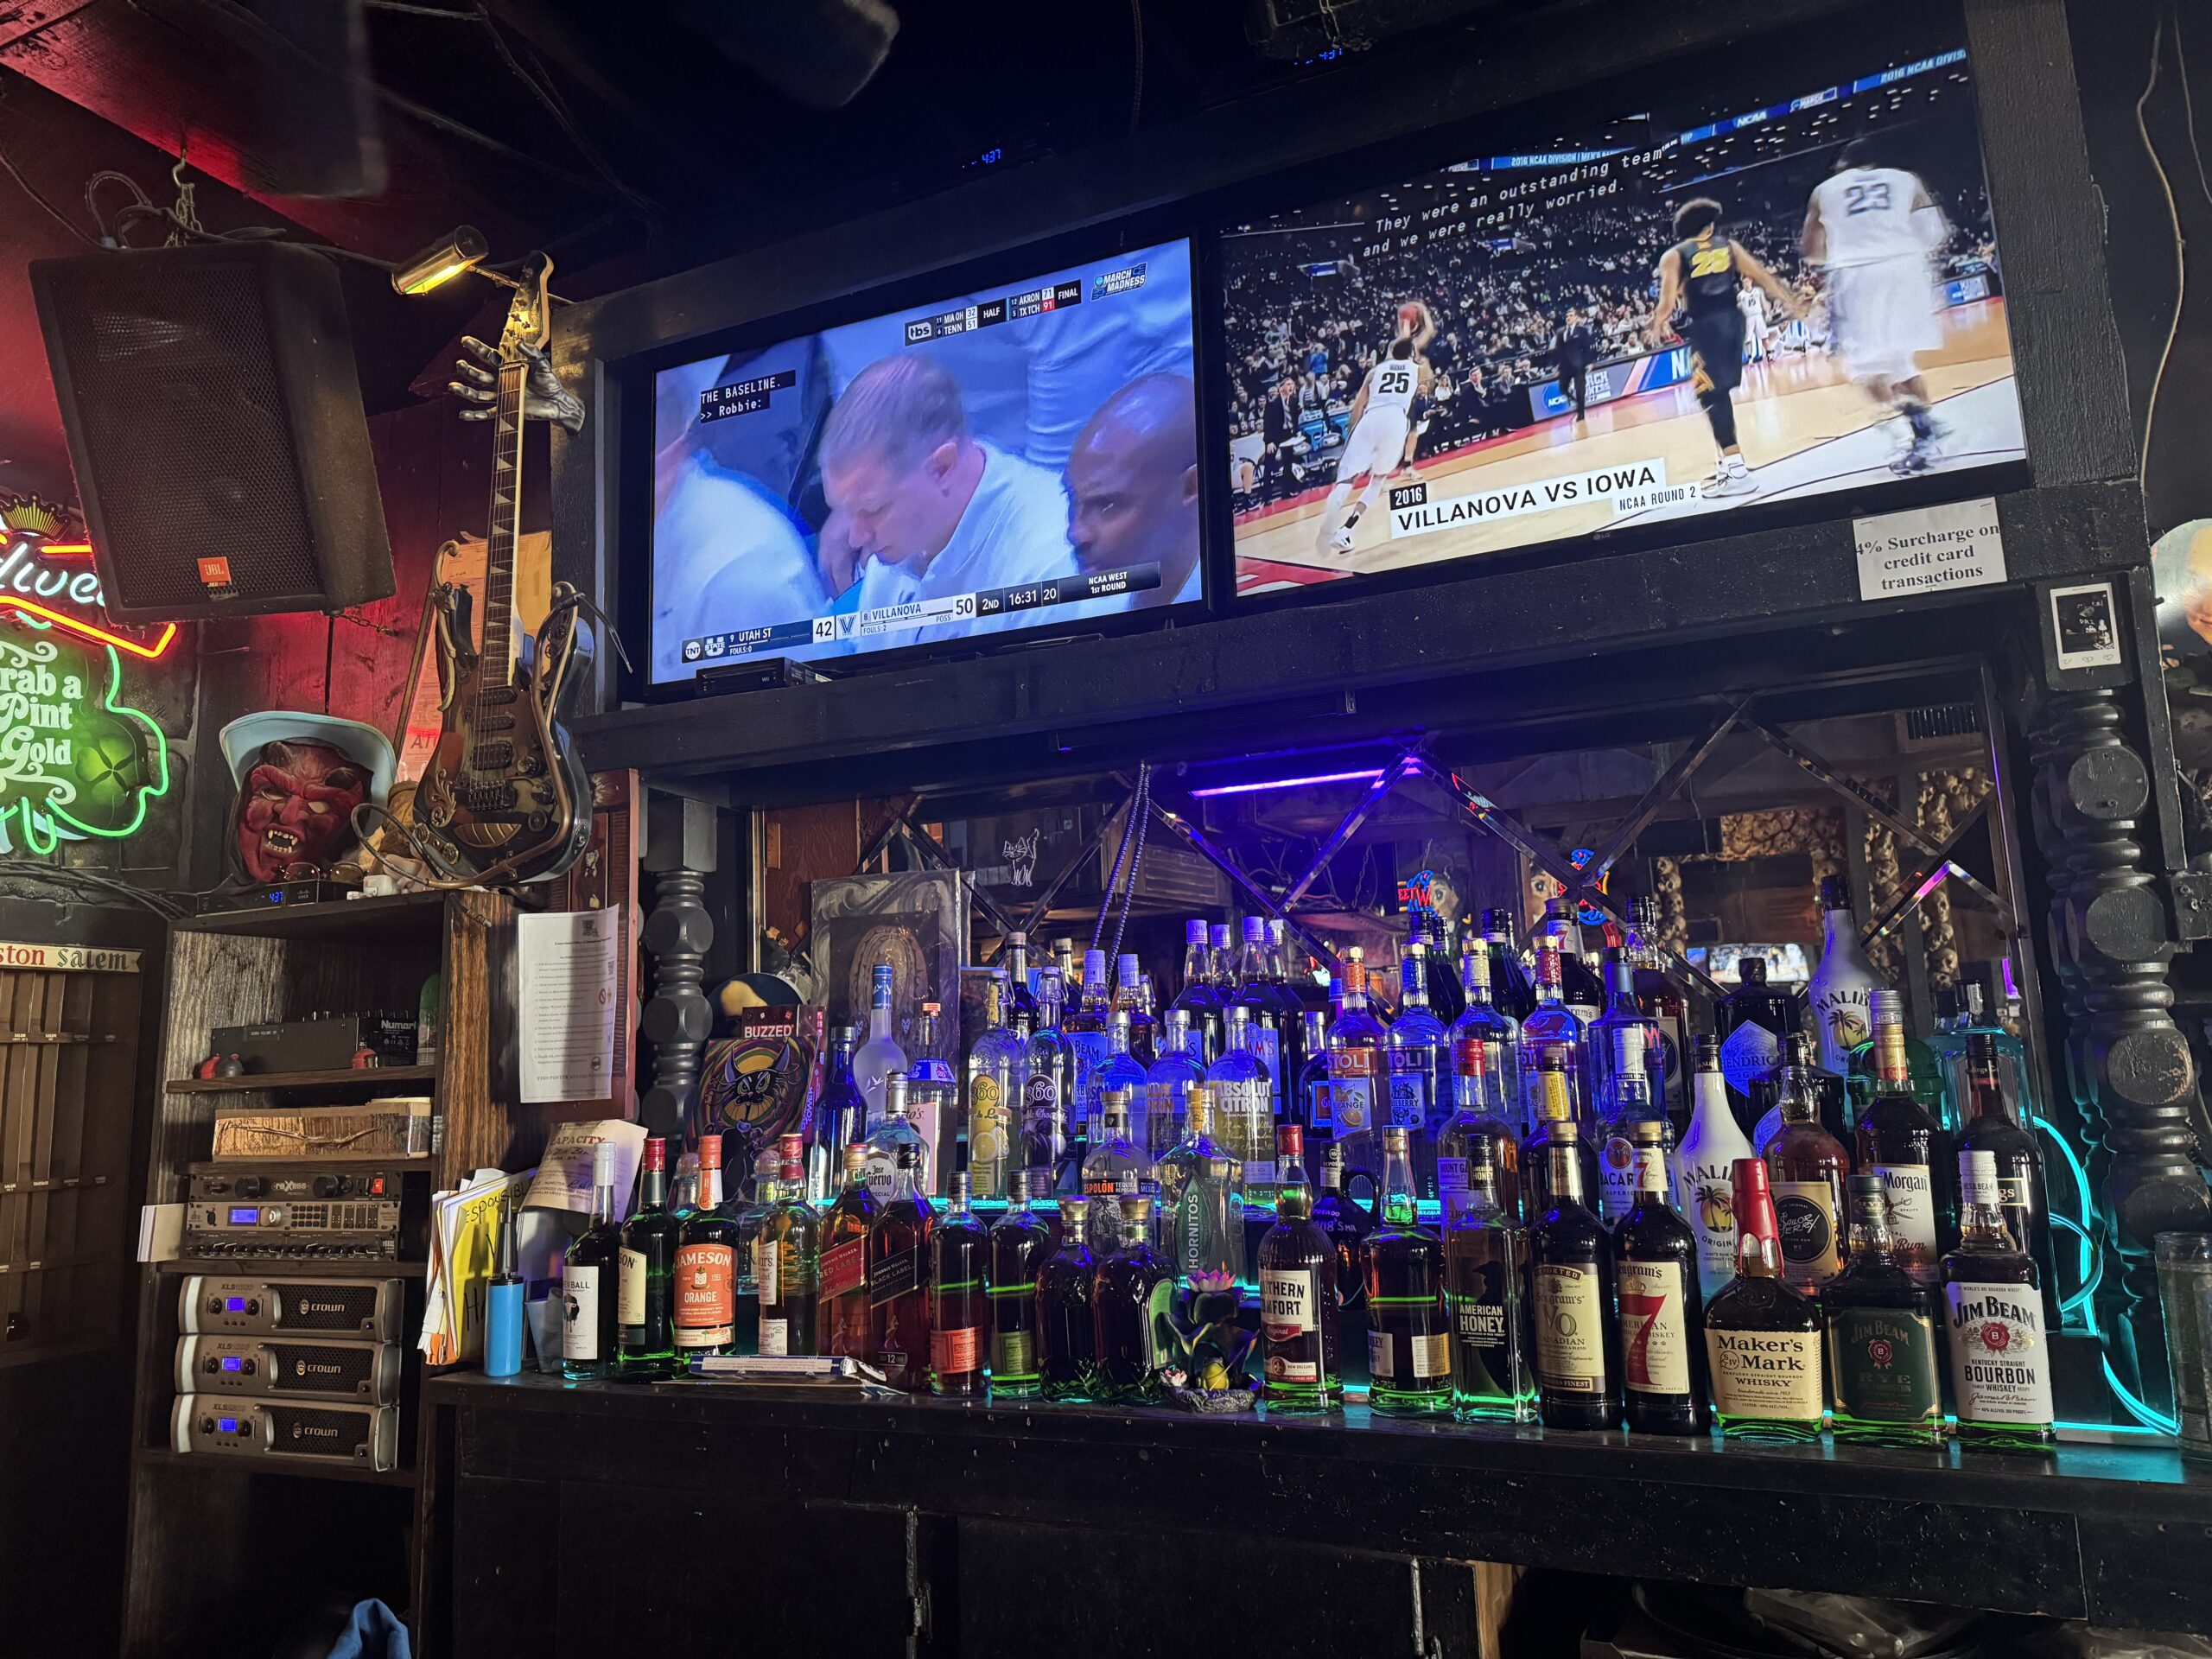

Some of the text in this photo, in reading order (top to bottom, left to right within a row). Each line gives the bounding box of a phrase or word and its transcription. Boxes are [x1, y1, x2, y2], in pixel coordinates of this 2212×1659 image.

[982, 149, 1001, 163] 437
[1376, 214, 1411, 233] They
[1422, 202, 1459, 220] were
[1470, 194, 1487, 208] an
[1499, 162, 1608, 200] outstanding
[1845, 183, 1891, 216] 23
[1363, 180, 1624, 257] and we were really worried.
[1103, 270, 1132, 285] MARCH
[1107, 275, 1145, 293] MADNESS
[1019, 293, 1040, 306] AKRON
[1044, 288, 1053, 299] 71
[1058, 288, 1078, 300] FINAL
[983, 307, 1001, 319] HALF
[1043, 301, 1053, 311] 91
[944, 314, 955, 324] MIA
[955, 312, 963, 321] OH
[967, 308, 976, 318] 32
[910, 326, 931, 338] tbs
[944, 324, 963, 336] TENN
[967, 319, 976, 328] 51
[701, 377, 781, 404] THE BASELINE.
[1381, 372, 1410, 393] 25
[719, 399, 762, 416] Robbie:
[1395, 487, 1424, 505] 2016
[1398, 467, 1656, 531] VILLANOVA VS IOWA
[1619, 486, 1696, 512] NCAA ROUND 2
[1888, 526, 1974, 550] Surcharge
[1979, 524, 2000, 536] on
[1885, 545, 1974, 569] credit card
[204, 563, 225, 575] JBL
[1881, 564, 1984, 590] transactions
[1089, 571, 1128, 585] NCAA WEST
[1043, 588, 1057, 601] 20
[1090, 582, 1127, 594] 1ST ROUND
[956, 597, 973, 615] 50
[982, 598, 999, 611] 2ND
[1009, 590, 1037, 606] 16:31
[872, 603, 921, 620] VILLANOVA
[936, 613, 951, 623] POSS
[739, 630, 760, 642] UTAH
[763, 627, 772, 639] ST
[816, 620, 832, 637] 42
[685, 645, 701, 656] TNT
[63, 675, 83, 699] a
[0, 691, 73, 733] Pint
[0, 726, 73, 772] Gold
[57, 947, 130, 971] Salem
[1817, 991, 1870, 1016] MALIB
[744, 1025, 792, 1039] BUZZED
[1075, 1040, 1099, 1060] BEAM
[971, 1082, 1000, 1106] 360
[1027, 1081, 1057, 1106] 360
[1217, 1082, 1271, 1097] ABSOLUT
[1219, 1097, 1269, 1113] CITRON
[873, 1165, 884, 1174] Jose
[1472, 1172, 1494, 1180] HONEY
[1683, 1165, 1732, 1190] MALI
[1881, 1171, 1927, 1192] Morgan
[1188, 1194, 1198, 1269] HORNITOS
[1701, 1236, 1732, 1248] ORIGIN
[1894, 1238, 1926, 1250] Rum
[676, 1251, 732, 1269] JAMESON
[871, 1274, 891, 1286] BLACK
[684, 1291, 717, 1303] ORANGE
[311, 1303, 345, 1313] crown
[1459, 1305, 1503, 1316] AMERICAN
[1953, 1296, 2036, 1332] JIM BEAM
[1618, 1293, 1668, 1387] 7
[1851, 1320, 1910, 1346] JIM BEAM
[1991, 1332, 1999, 1340] B
[1717, 1335, 1803, 1352] Maker's
[887, 1354, 896, 1363] 12
[1740, 1354, 1805, 1371] Mark
[308, 1364, 341, 1374] crown
[1964, 1365, 2036, 1384] BOURBON
[1735, 1377, 1792, 1387] WHISKY
[304, 1427, 338, 1437] crown
